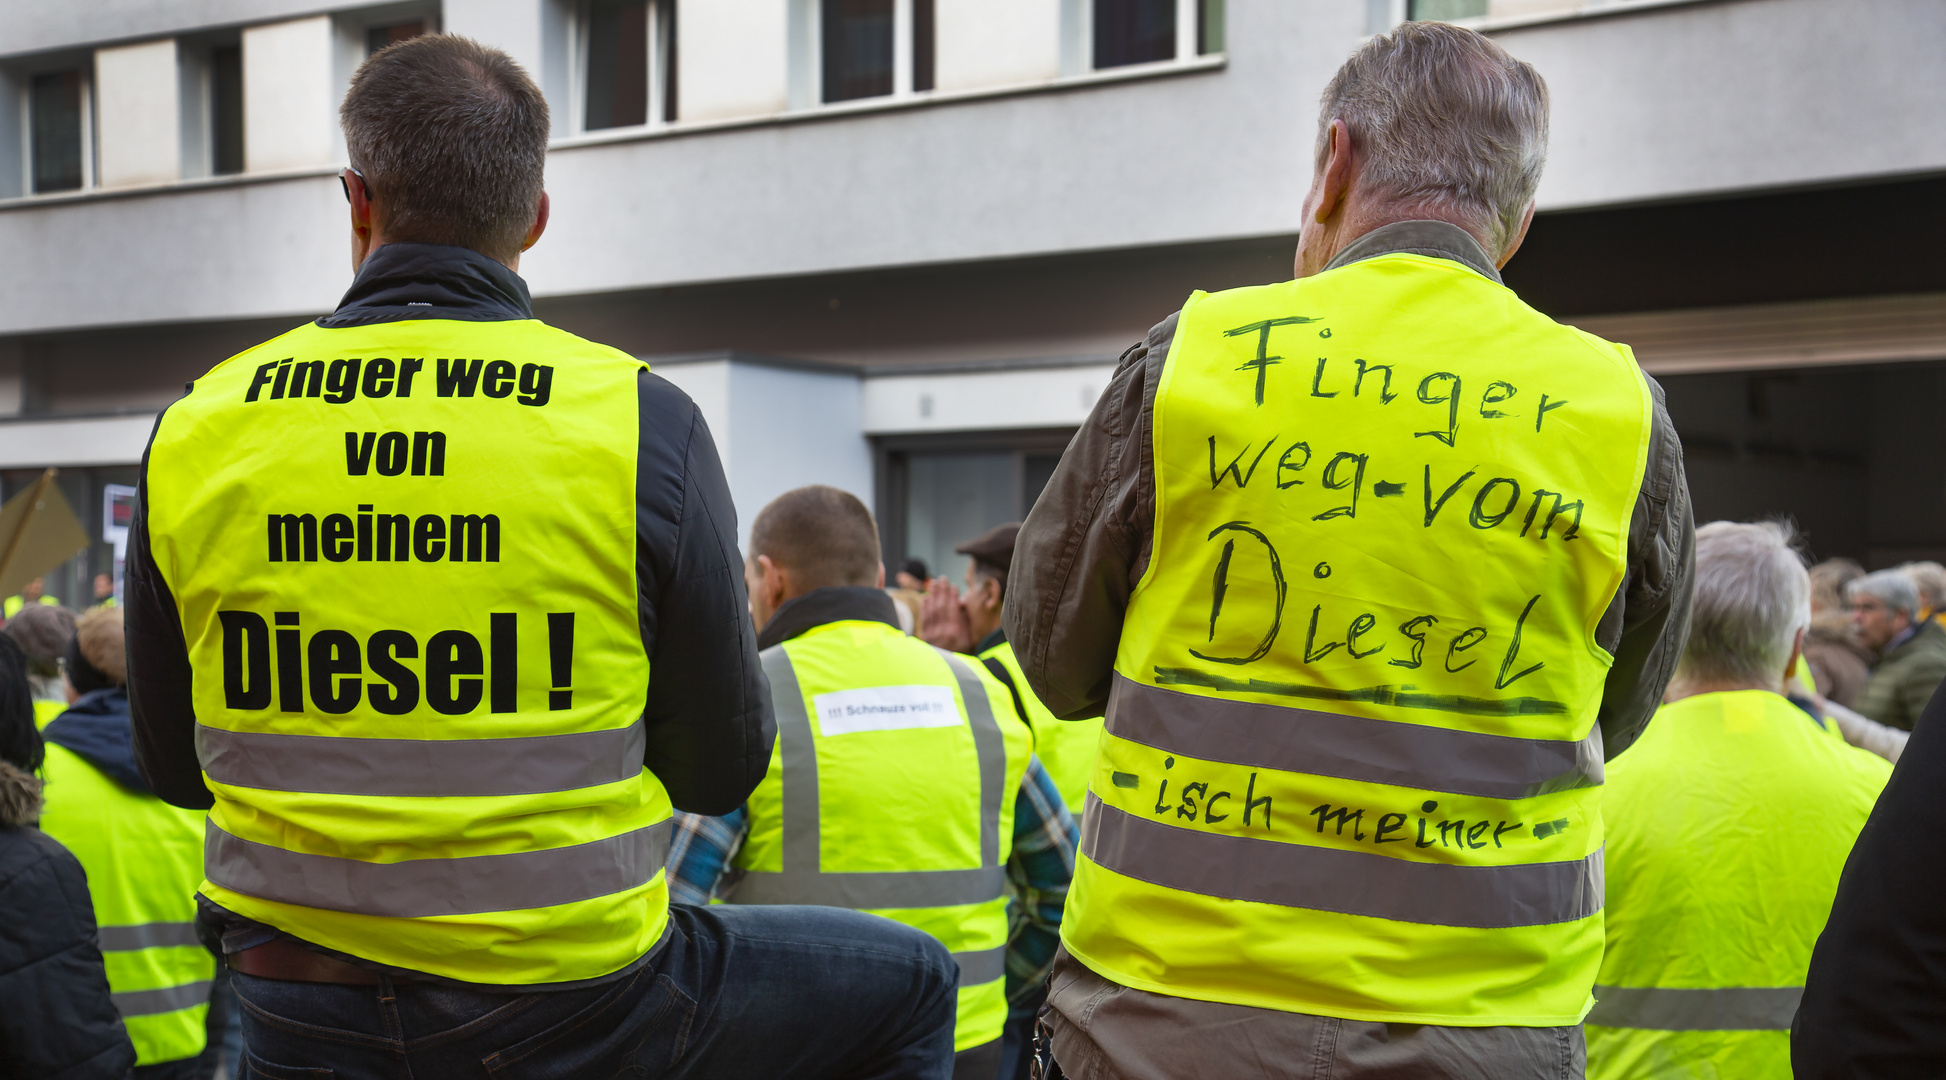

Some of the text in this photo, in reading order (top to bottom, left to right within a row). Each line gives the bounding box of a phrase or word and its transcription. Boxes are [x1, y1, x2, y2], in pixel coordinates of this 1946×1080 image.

[245, 357, 554, 407] Finger weg
[1224, 316, 1569, 447] Finger
[345, 431, 447, 477] von
[267, 503, 501, 563] meinem
[1189, 520, 1546, 690] Diesel
[217, 610, 576, 716] Diesel !
[846, 704, 905, 717] Schnauze
[909, 702, 929, 713] voll
